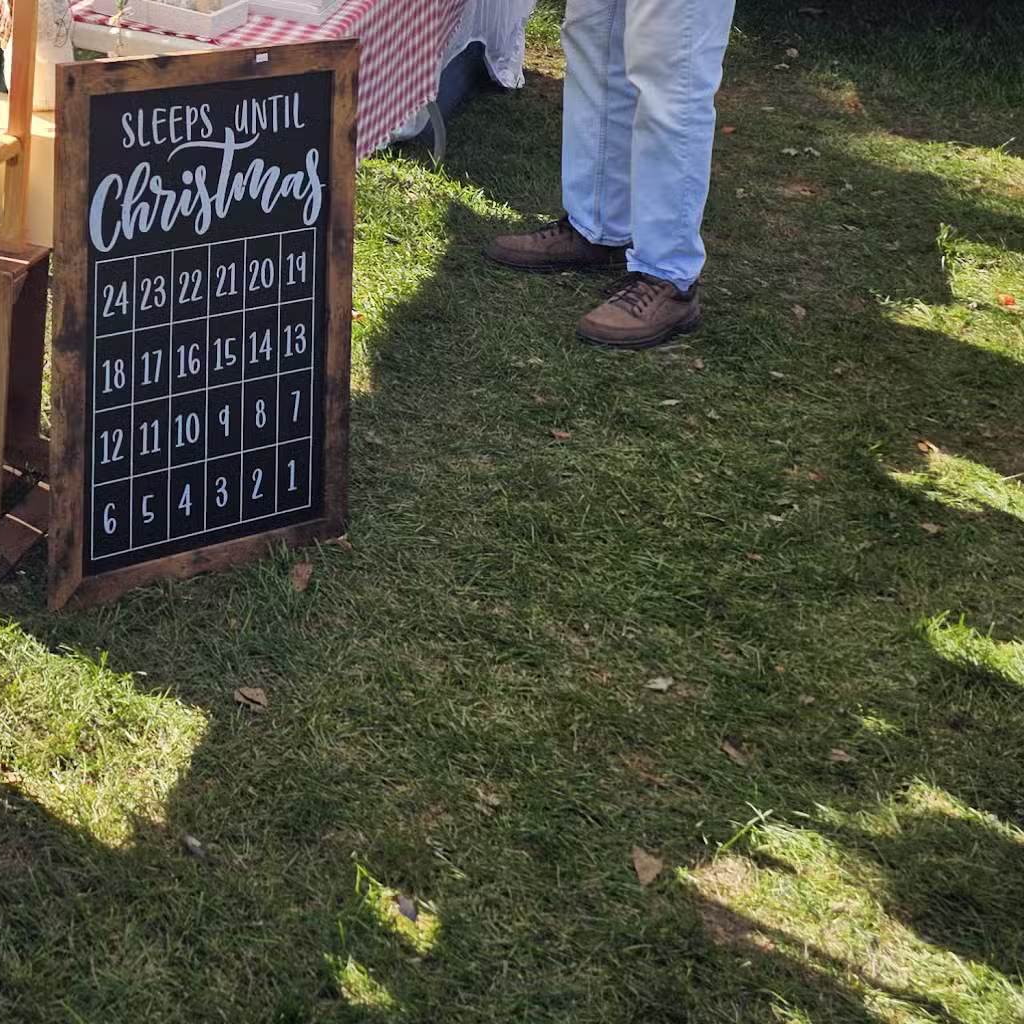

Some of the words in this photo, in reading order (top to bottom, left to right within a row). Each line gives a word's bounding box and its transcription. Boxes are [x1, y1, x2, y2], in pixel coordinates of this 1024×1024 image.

[121, 103, 213, 148] SLEEPS
[235, 92, 305, 134] UNTIL
[89, 126, 326, 253] Christmas
[102, 281, 128, 317] 24
[140, 276, 166, 310] 23
[179, 269, 203, 304] 22
[216, 262, 238, 297] 21
[249, 258, 274, 291] 20
[286, 251, 306, 285] 19
[102, 359, 126, 393] 18
[141, 349, 163, 386] 17
[177, 343, 200, 378] 16
[213, 337, 237, 371] 15
[249, 329, 272, 364] 14
[284, 323, 306, 357] 13
[100, 428, 125, 464] 12
[139, 419, 161, 455] 11
[175, 412, 200, 448] 10
[218, 404, 230, 437] 9
[255, 399, 267, 428] 8
[290, 390, 301, 422] 7
[103, 502, 117, 535] 6
[142, 494, 154, 524] 5
[178, 483, 192, 517] 4
[215, 476, 228, 507] 3
[251, 468, 263, 500] 2
[287, 459, 298, 491] 1
